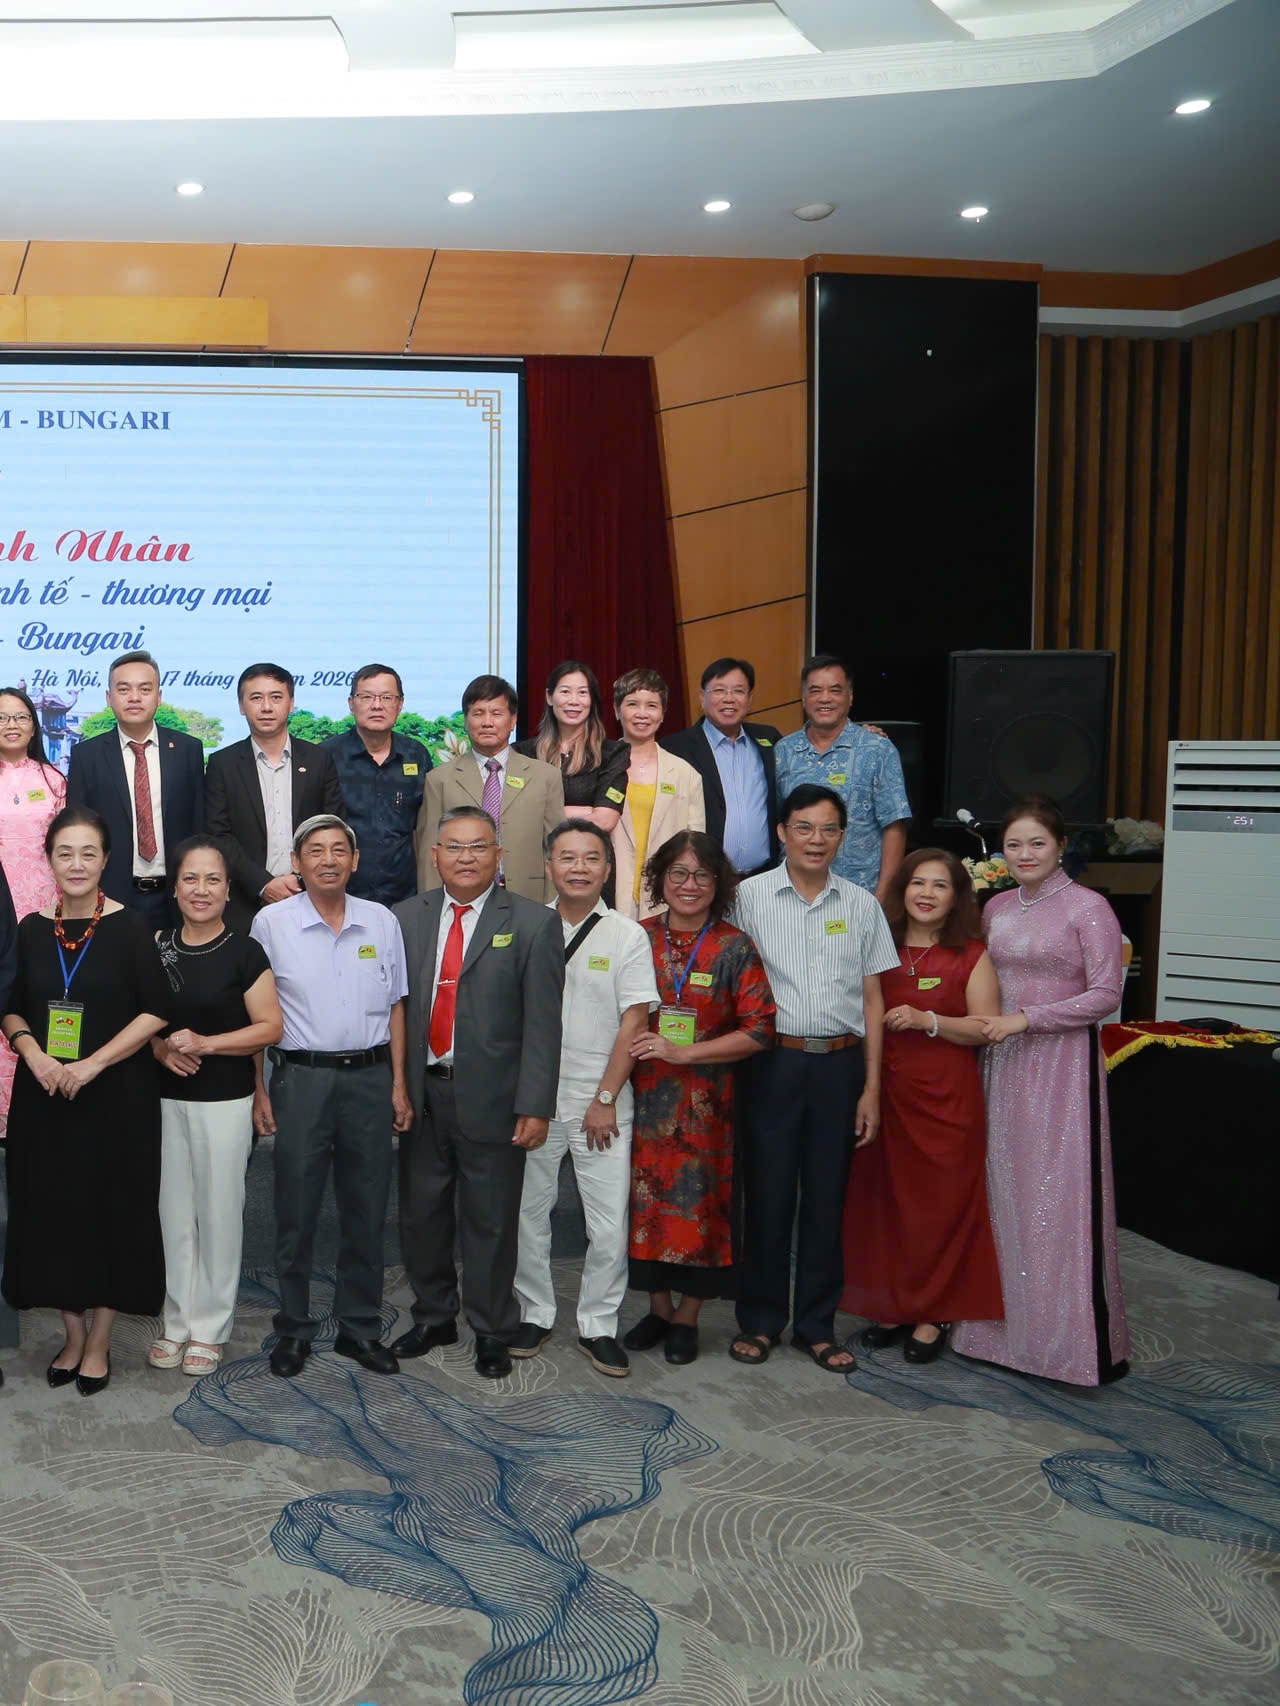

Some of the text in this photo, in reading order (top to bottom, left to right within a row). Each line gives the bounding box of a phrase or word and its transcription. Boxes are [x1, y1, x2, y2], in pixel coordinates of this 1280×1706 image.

[36, 409, 172, 431] BUNGARI
[55, 529, 195, 562] Nhân
[39, 576, 75, 606] tế
[101, 578, 207, 611] thương
[211, 580, 273, 613] mại
[17, 621, 147, 656] Bungari
[31, 669, 59, 687] Hà
[65, 668, 102, 692] Nội,
[160, 670, 182, 687] 17
[183, 670, 235, 690] tháng
[310, 670, 357, 687] 2026
